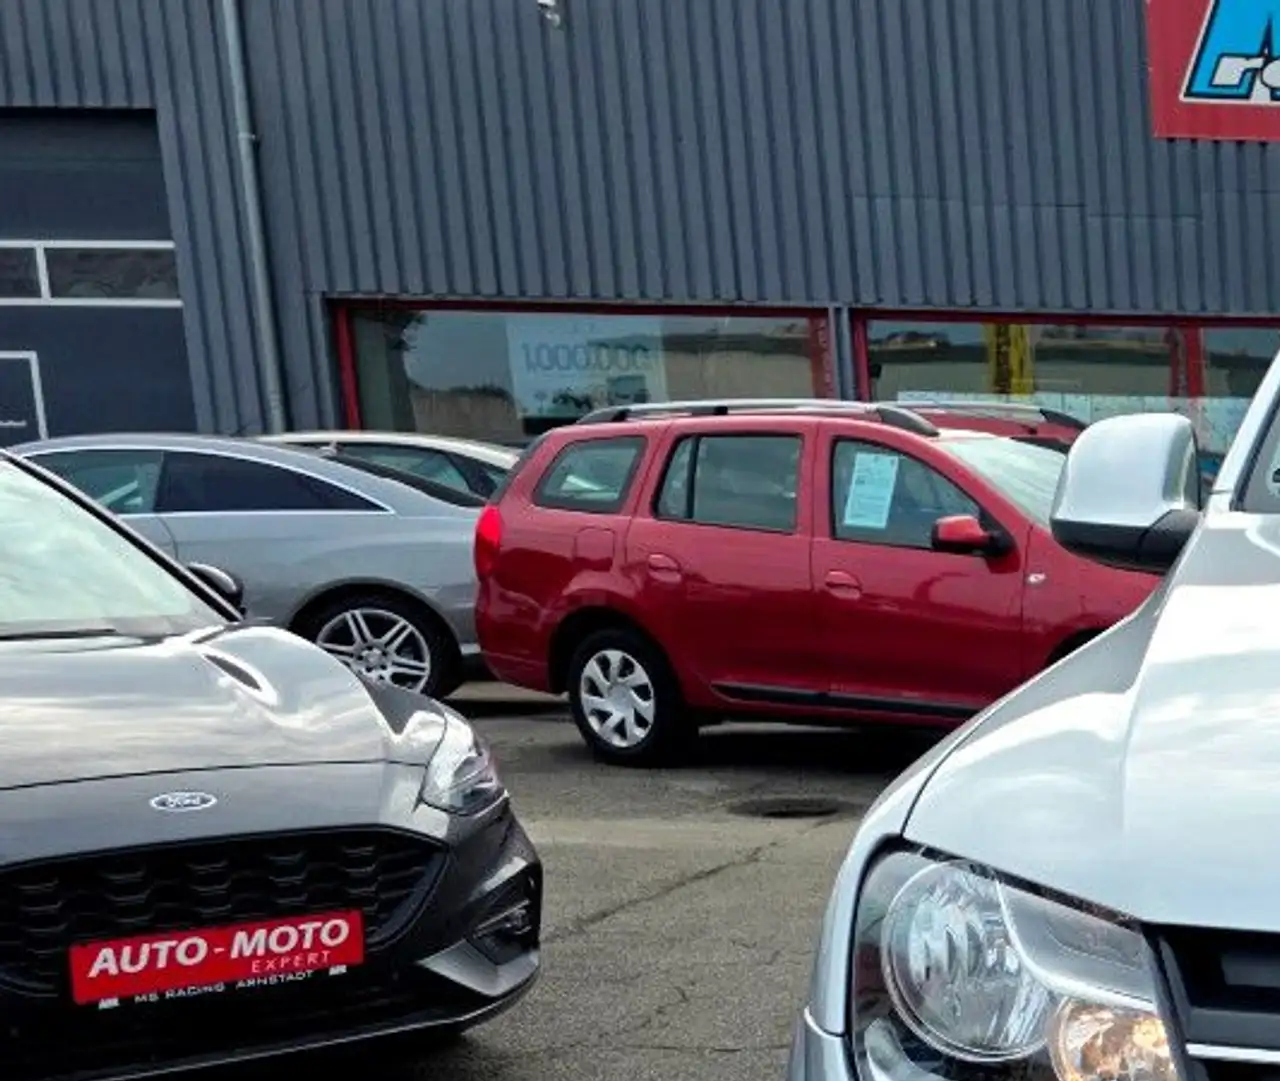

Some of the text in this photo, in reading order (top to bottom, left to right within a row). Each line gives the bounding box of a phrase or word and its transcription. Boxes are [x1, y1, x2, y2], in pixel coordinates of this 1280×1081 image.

[87, 936, 207, 978] AUTO
[230, 919, 350, 959] MOTO
[251, 950, 331, 973] EXPERT
